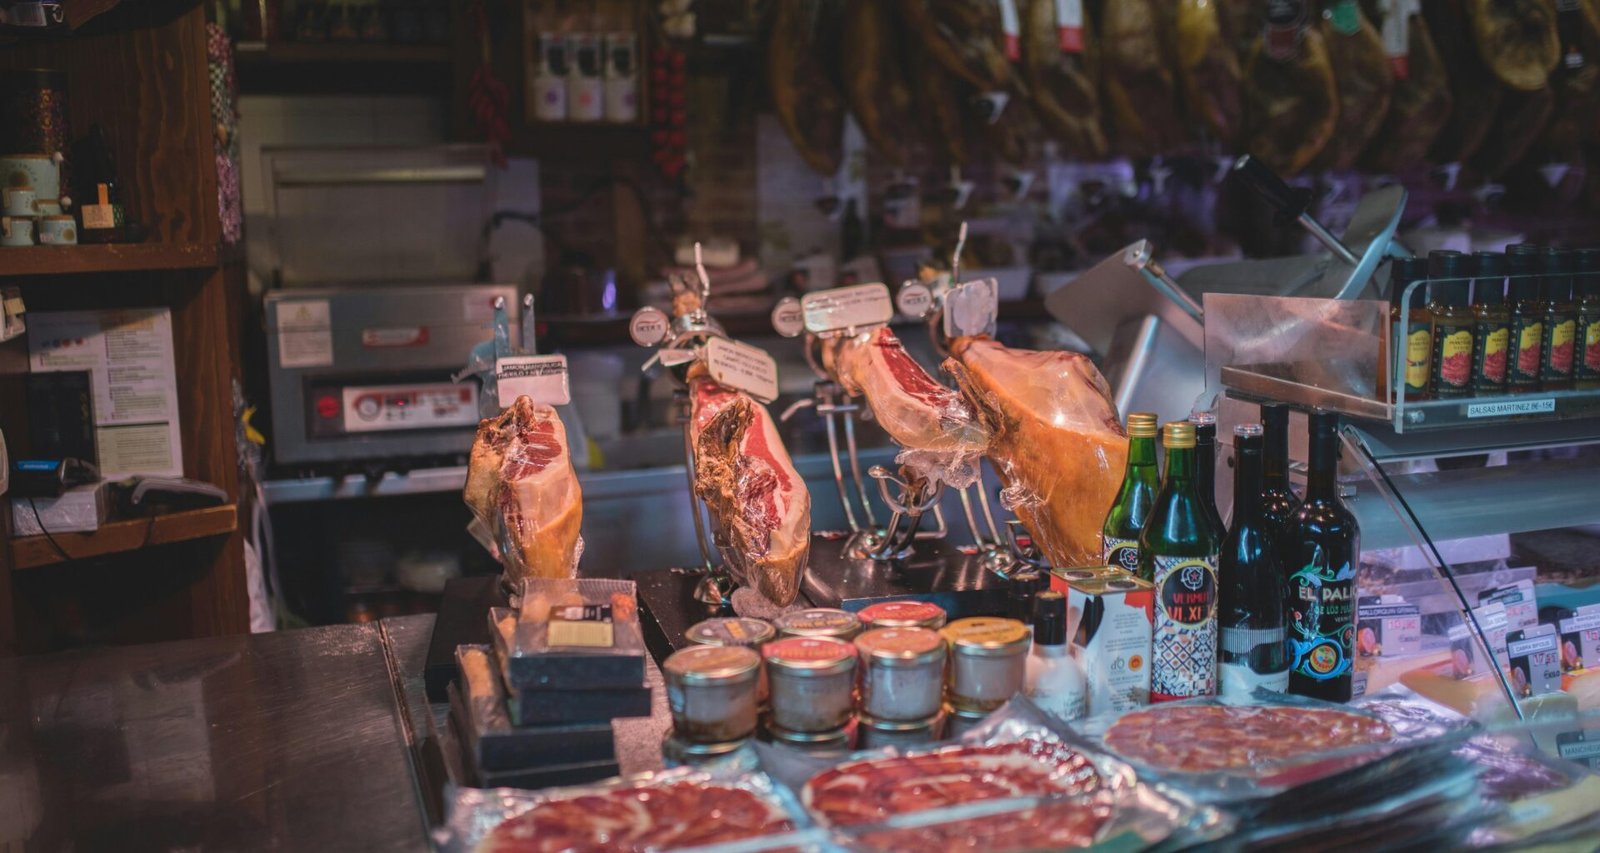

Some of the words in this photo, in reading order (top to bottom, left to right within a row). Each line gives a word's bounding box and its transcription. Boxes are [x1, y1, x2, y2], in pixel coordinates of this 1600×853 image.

[1470, 406, 1495, 415] SALSAS
[1497, 402, 1530, 412] MARTINEZ
[1299, 586, 1317, 600] EL
